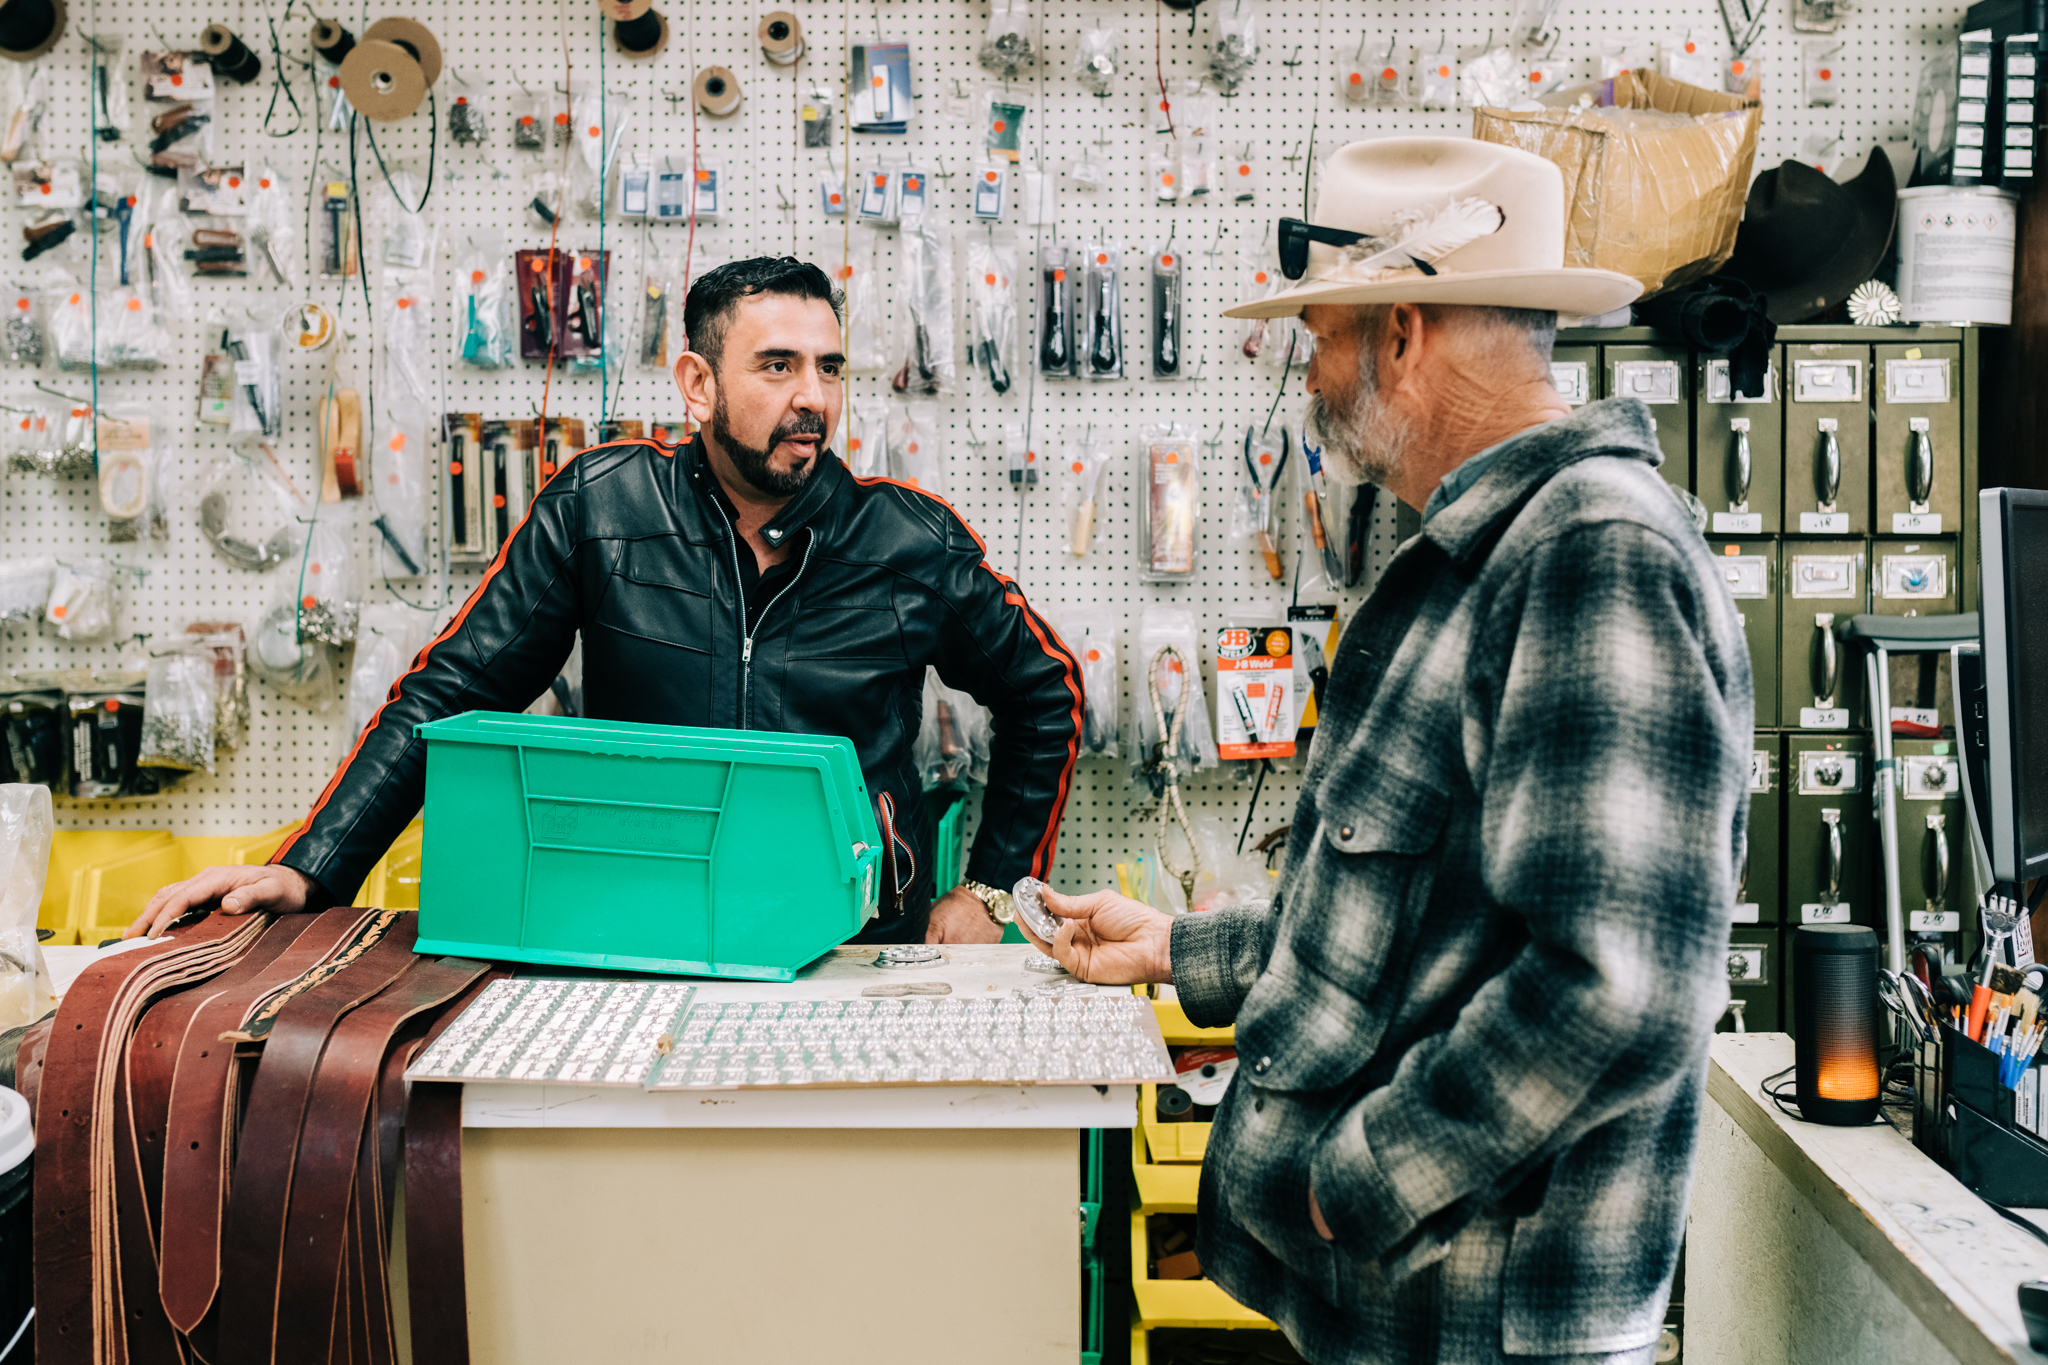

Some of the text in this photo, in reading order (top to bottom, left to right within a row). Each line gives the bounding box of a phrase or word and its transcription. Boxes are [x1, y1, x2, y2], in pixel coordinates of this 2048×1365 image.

[1220, 647, 1249, 658] WELD
[1249, 658, 1274, 669] Weld
[584, 807, 708, 824] QUANTUM STORAGE
[619, 819, 673, 831] SYSTEMS
[618, 834, 678, 846] ULTRA 265
